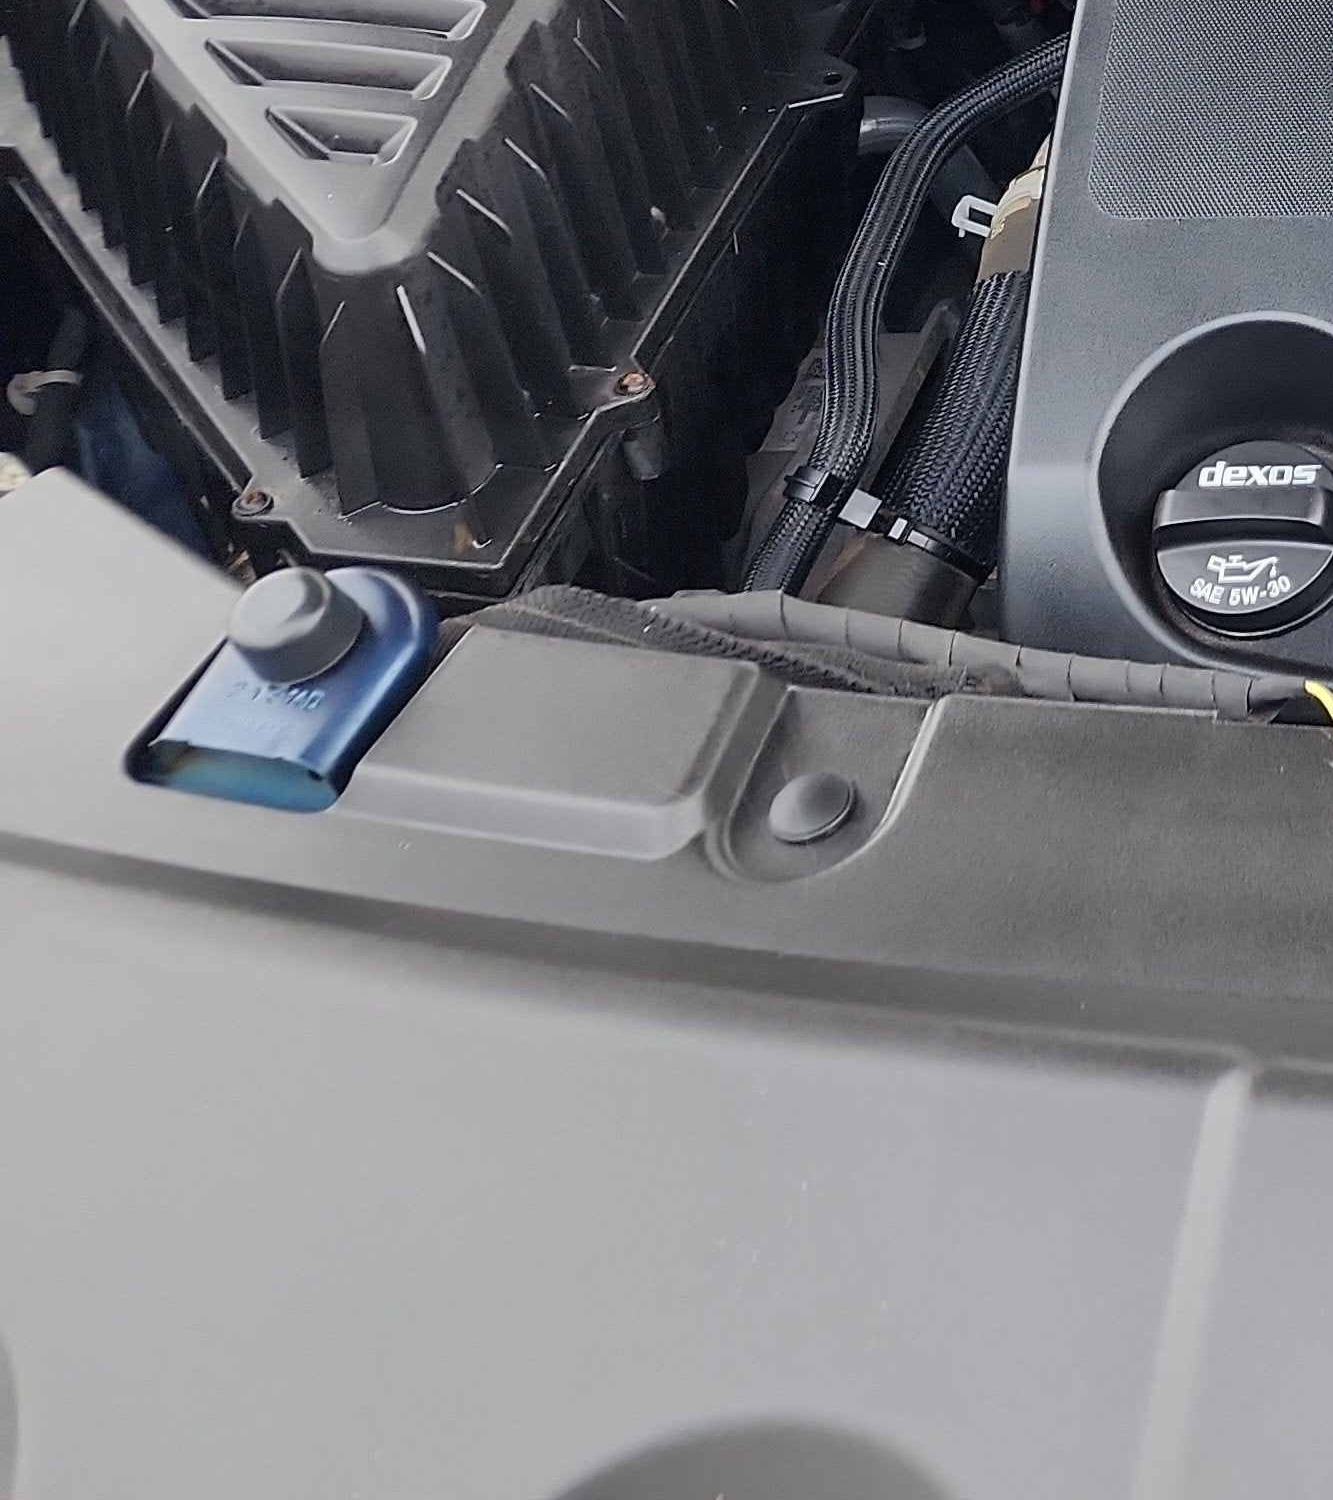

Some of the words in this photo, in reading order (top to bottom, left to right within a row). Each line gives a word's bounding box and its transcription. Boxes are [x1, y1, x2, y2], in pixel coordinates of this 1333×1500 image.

[1197, 460, 1322, 488] dexos
[1189, 577, 1225, 605] SAE
[1228, 574, 1292, 607] 5W-30
